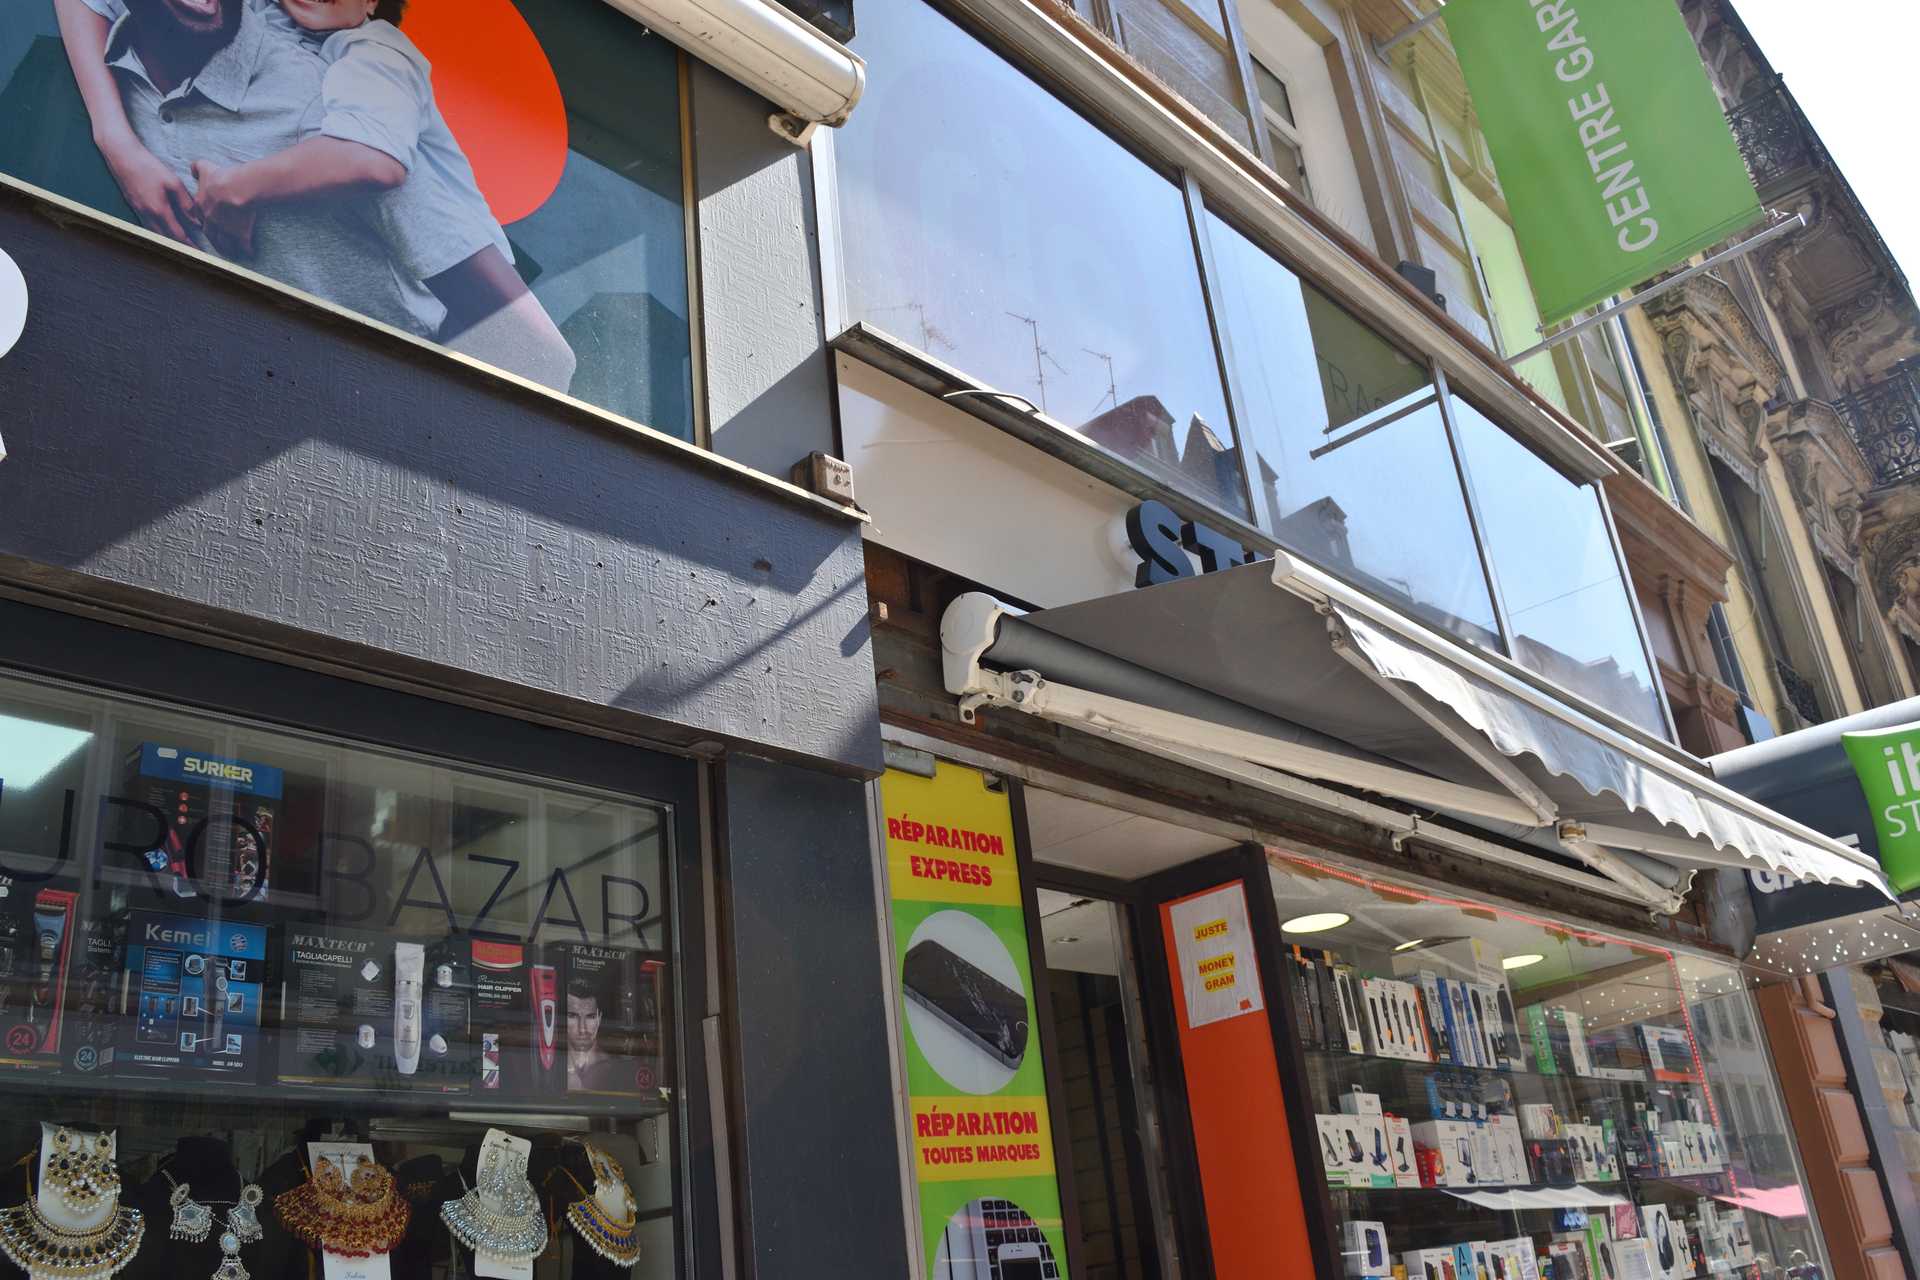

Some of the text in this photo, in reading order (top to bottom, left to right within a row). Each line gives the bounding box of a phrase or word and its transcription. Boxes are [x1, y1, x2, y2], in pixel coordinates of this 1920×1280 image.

[1530, 0, 1659, 253] CENTRE GAR
[183, 757, 253, 783] SURKER
[888, 814, 1004, 856] RÉPARATION
[911, 856, 992, 886] EXPRESS
[318, 831, 650, 950] BAZAR
[145, 923, 211, 946] Kemei
[1195, 921, 1228, 939] JUSTE
[292, 935, 368, 953] MAXTECH
[296, 951, 353, 964] TAGLIACAPELLI
[1198, 956, 1235, 975] MONEY
[1204, 974, 1236, 991] GRAM
[14, 1032, 30, 1047] 24
[916, 1106, 1039, 1137] RÉPARATION
[922, 1144, 1040, 1165] TOUTES MARQUES
